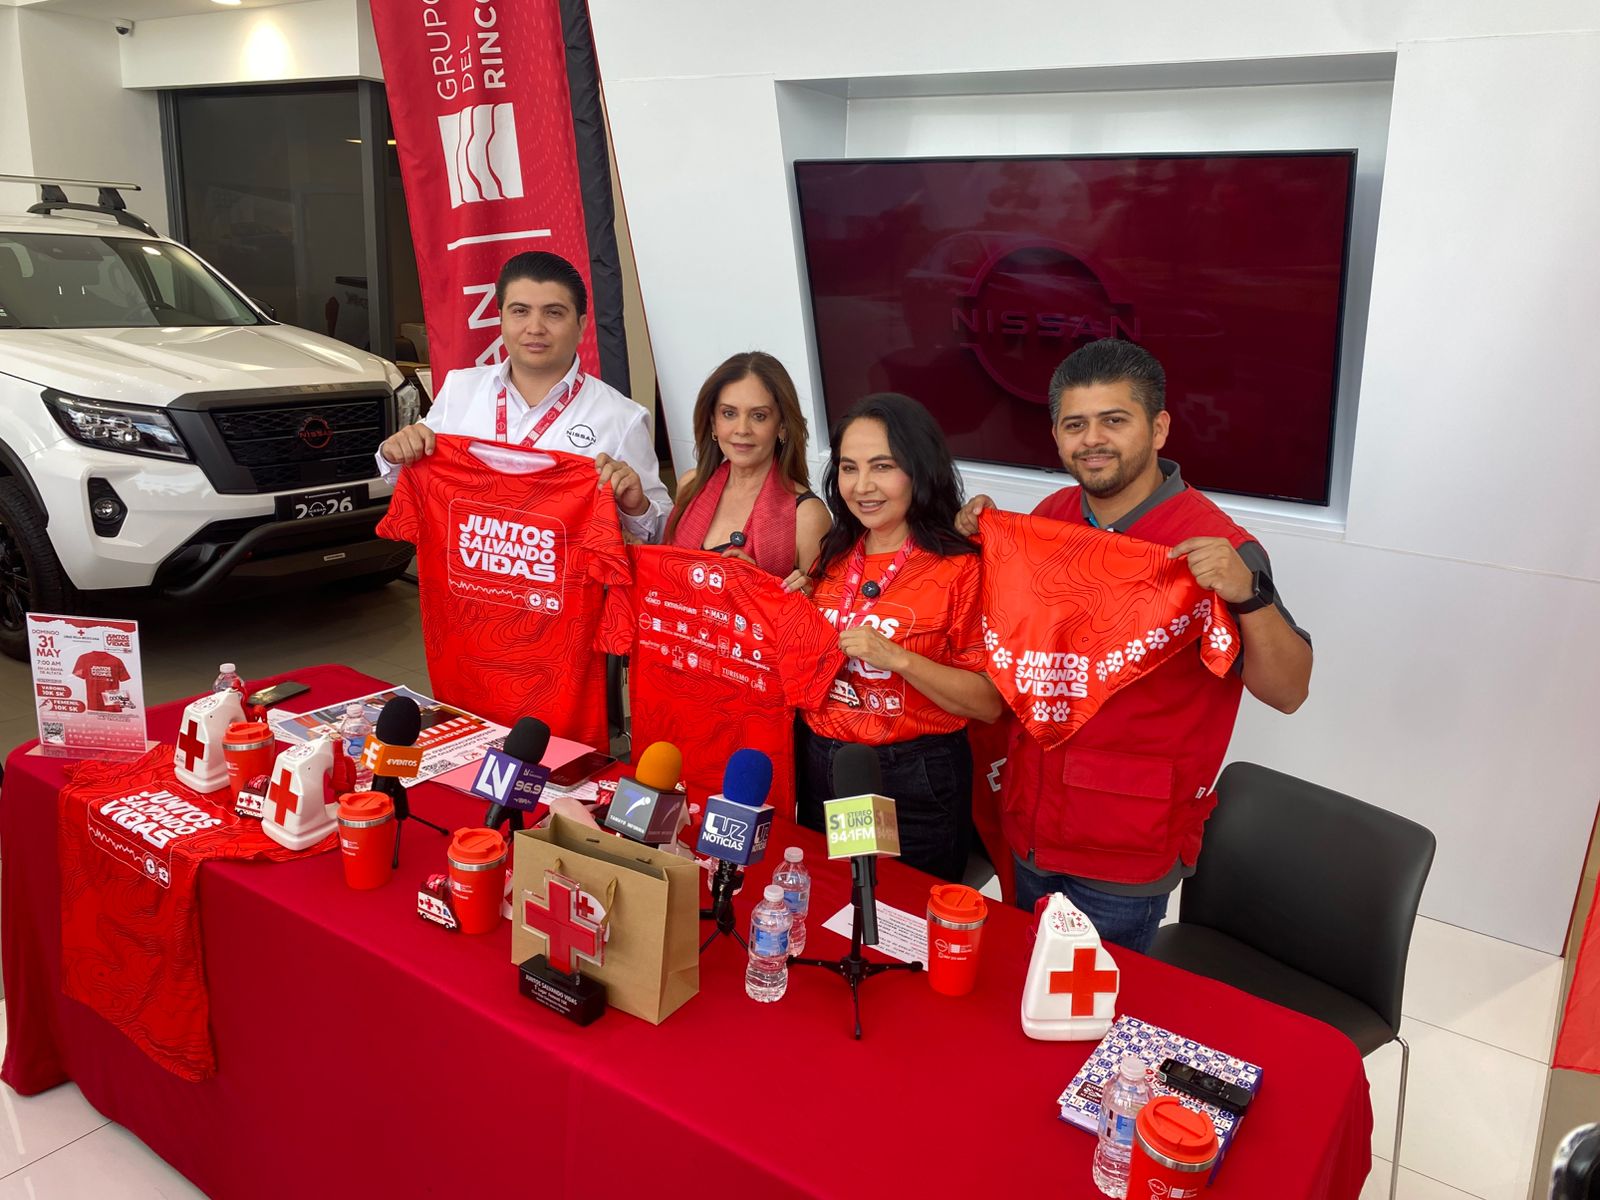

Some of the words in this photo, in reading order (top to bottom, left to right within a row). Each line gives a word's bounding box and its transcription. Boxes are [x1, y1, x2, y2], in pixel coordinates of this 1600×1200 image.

[423, 0, 458, 100] GRUP
[474, 0, 506, 89] RINC
[459, 34, 475, 93] DEL
[951, 307, 1141, 341] NISSAN
[566, 430, 597, 443] NISSAN
[459, 514, 556, 549] JUNTOS
[459, 532, 556, 564] SALVANDO
[459, 547, 556, 583] VIDAS
[36, 648, 61, 658] MAY
[38, 635, 55, 648] 31
[1015, 665, 1089, 683] SALVANDO
[1016, 650, 1089, 671] JUNTOS
[1015, 678, 1088, 698] VIDAS
[514, 780, 542, 795] 96.9
[100, 800, 178, 849] VIDAS
[120, 795, 197, 835] SALVANDO
[139, 790, 222, 829] JUNTOS
[847, 809, 872, 818] STEREO
[848, 815, 873, 828] UNO
[702, 832, 744, 851] NOTICIAS
[704, 812, 748, 843] LUZ
